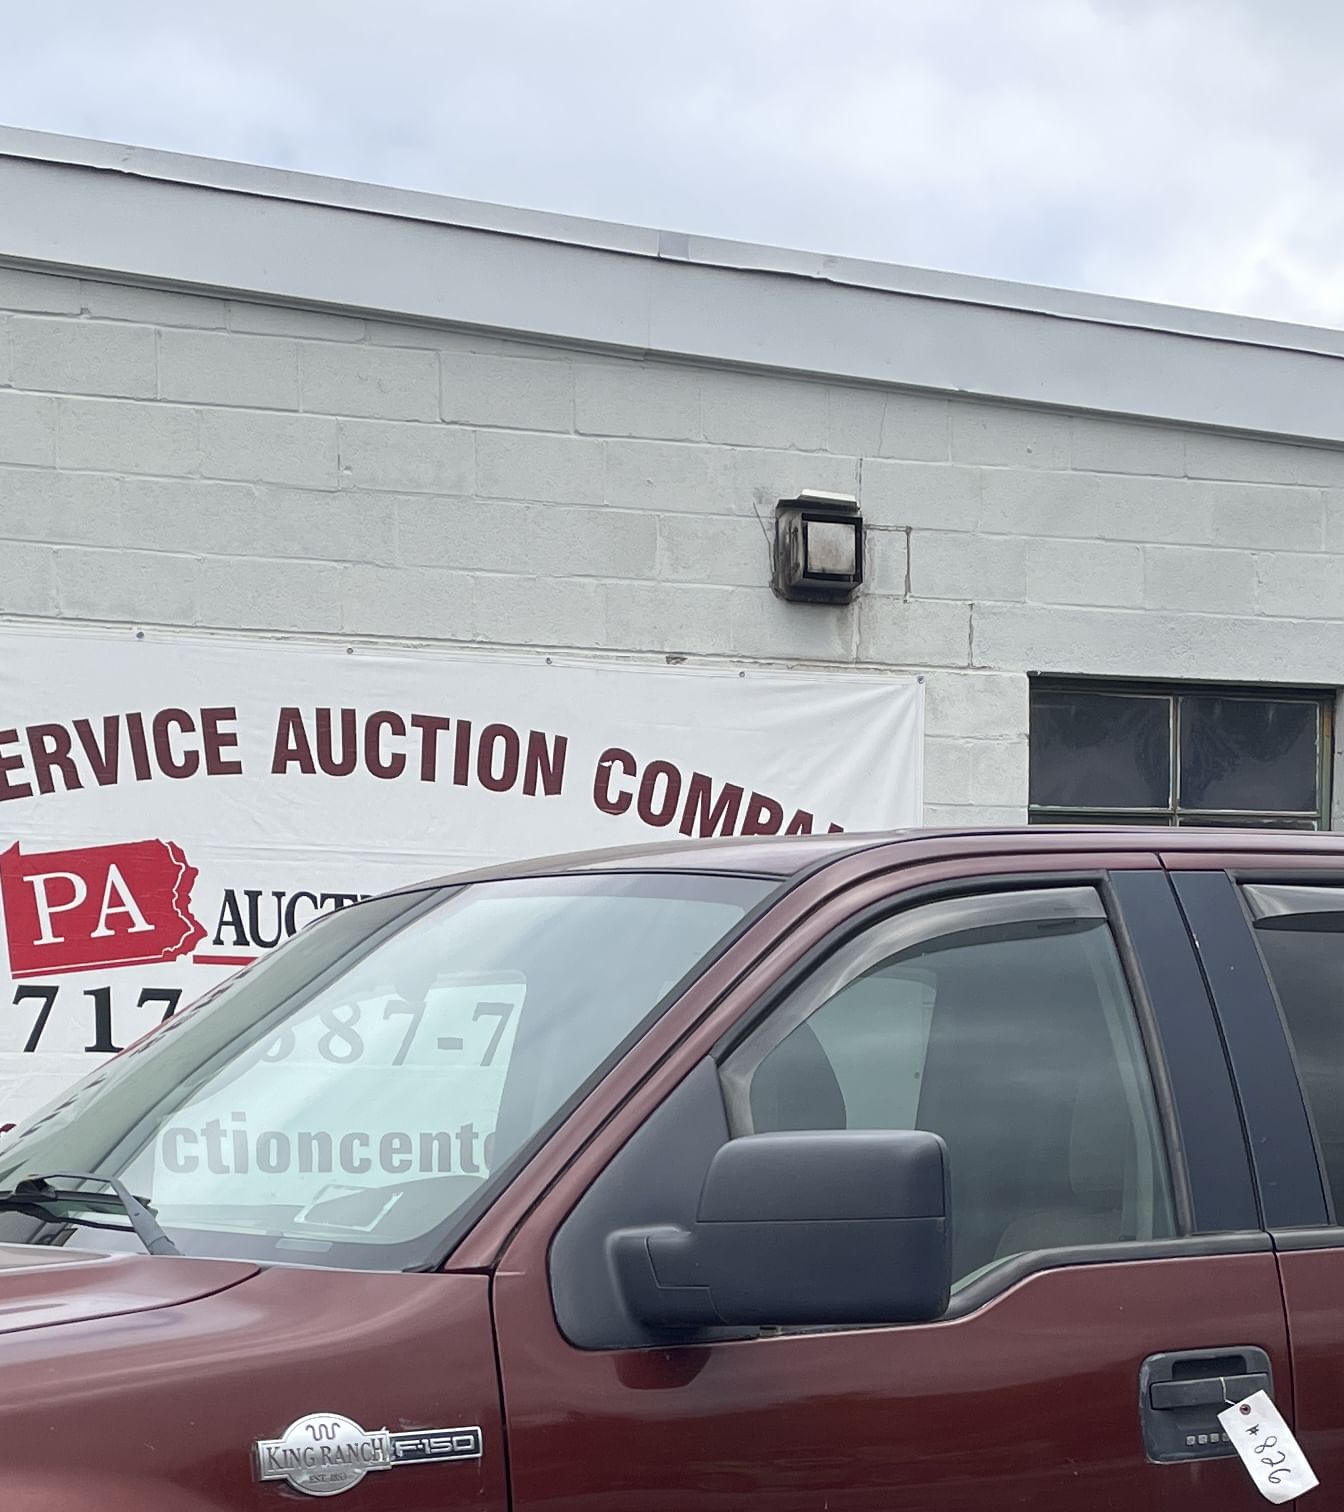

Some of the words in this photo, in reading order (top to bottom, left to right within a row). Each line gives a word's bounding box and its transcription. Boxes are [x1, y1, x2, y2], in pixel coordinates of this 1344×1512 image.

[270, 706, 568, 797] AUCTION
[592, 747, 844, 838] COMP
[23, 863, 155, 947] PA
[212, 888, 376, 949] AUCT
[266, 1445, 315, 1471] KING
[321, 1437, 385, 1467] RANCH
[395, 1434, 475, 1457] F-150
